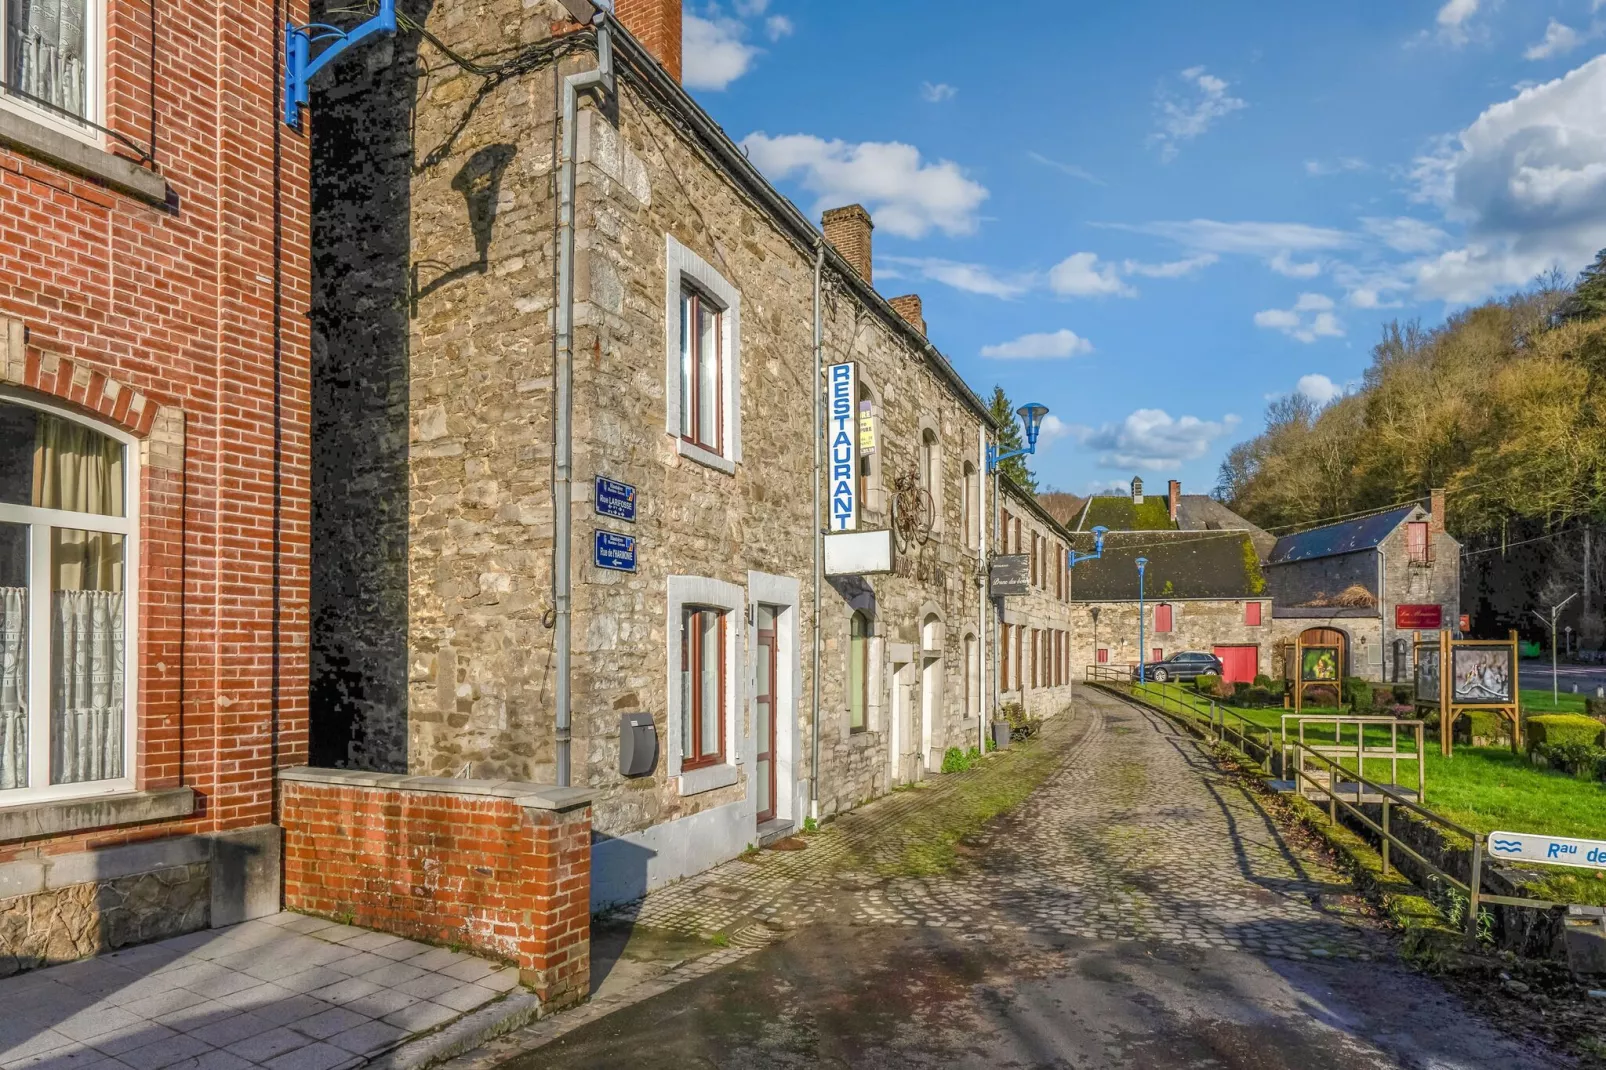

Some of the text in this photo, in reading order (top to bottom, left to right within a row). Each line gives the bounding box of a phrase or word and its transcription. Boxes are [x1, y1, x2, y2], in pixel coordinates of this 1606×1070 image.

[833, 365, 852, 530] RESTAURANT
[600, 494, 608, 504] Rue
[600, 547, 608, 556] Rue
[1547, 843, 1578, 858] Rau
